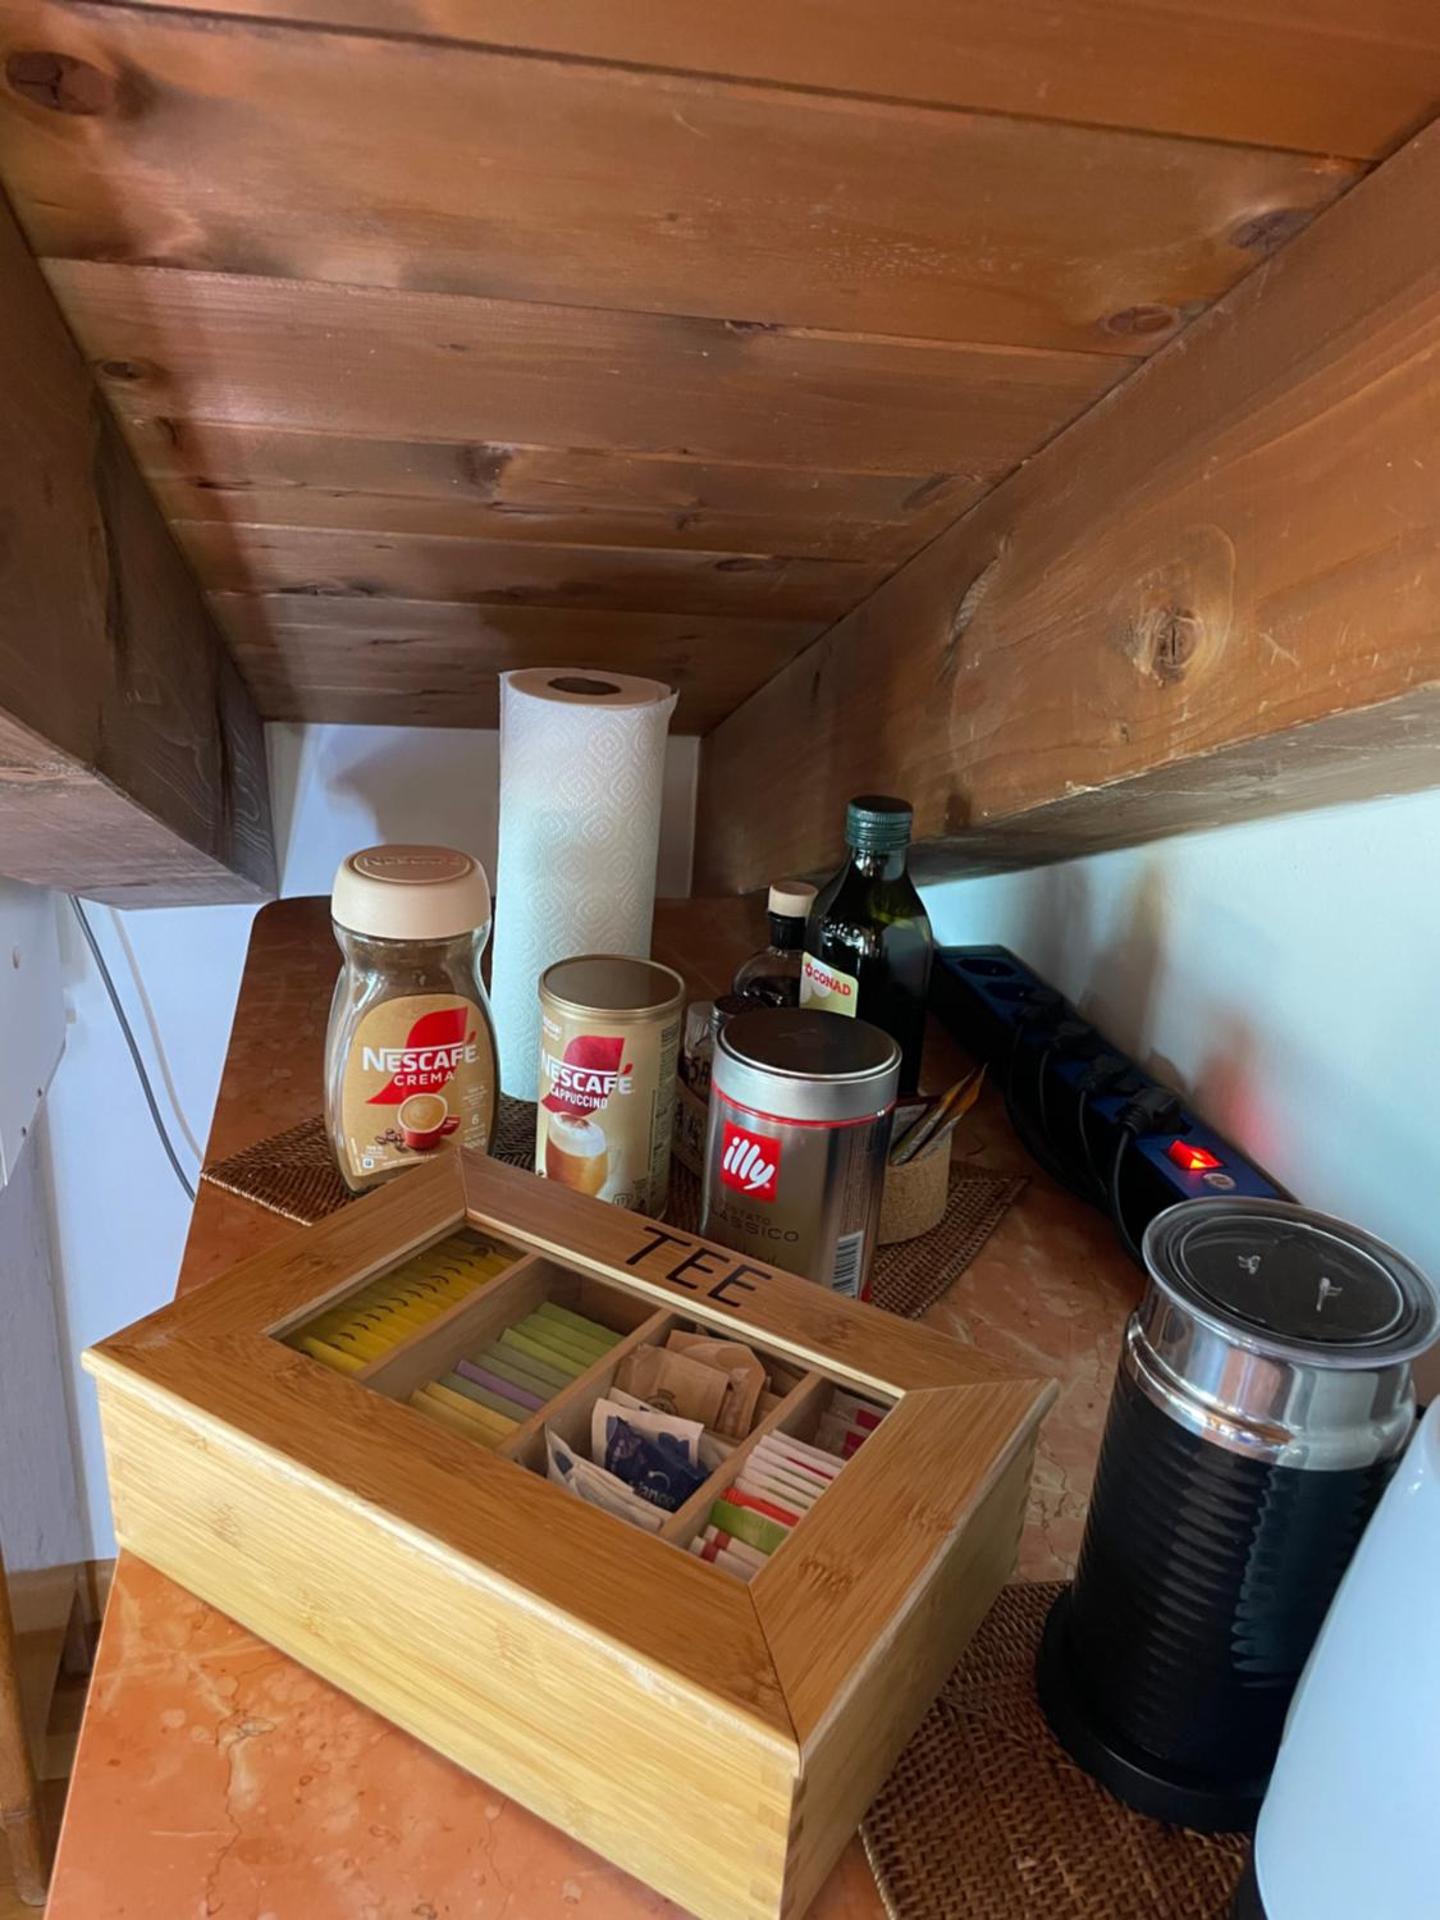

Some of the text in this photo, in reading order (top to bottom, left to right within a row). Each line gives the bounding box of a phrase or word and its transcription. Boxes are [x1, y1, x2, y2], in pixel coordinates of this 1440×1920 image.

[813, 969, 851, 996] CONAD
[393, 1070, 455, 1087] CREMA
[550, 1082, 609, 1110] CAPPUCCINO
[722, 1136, 776, 1191] illy
[625, 1226, 773, 1308] TEE
